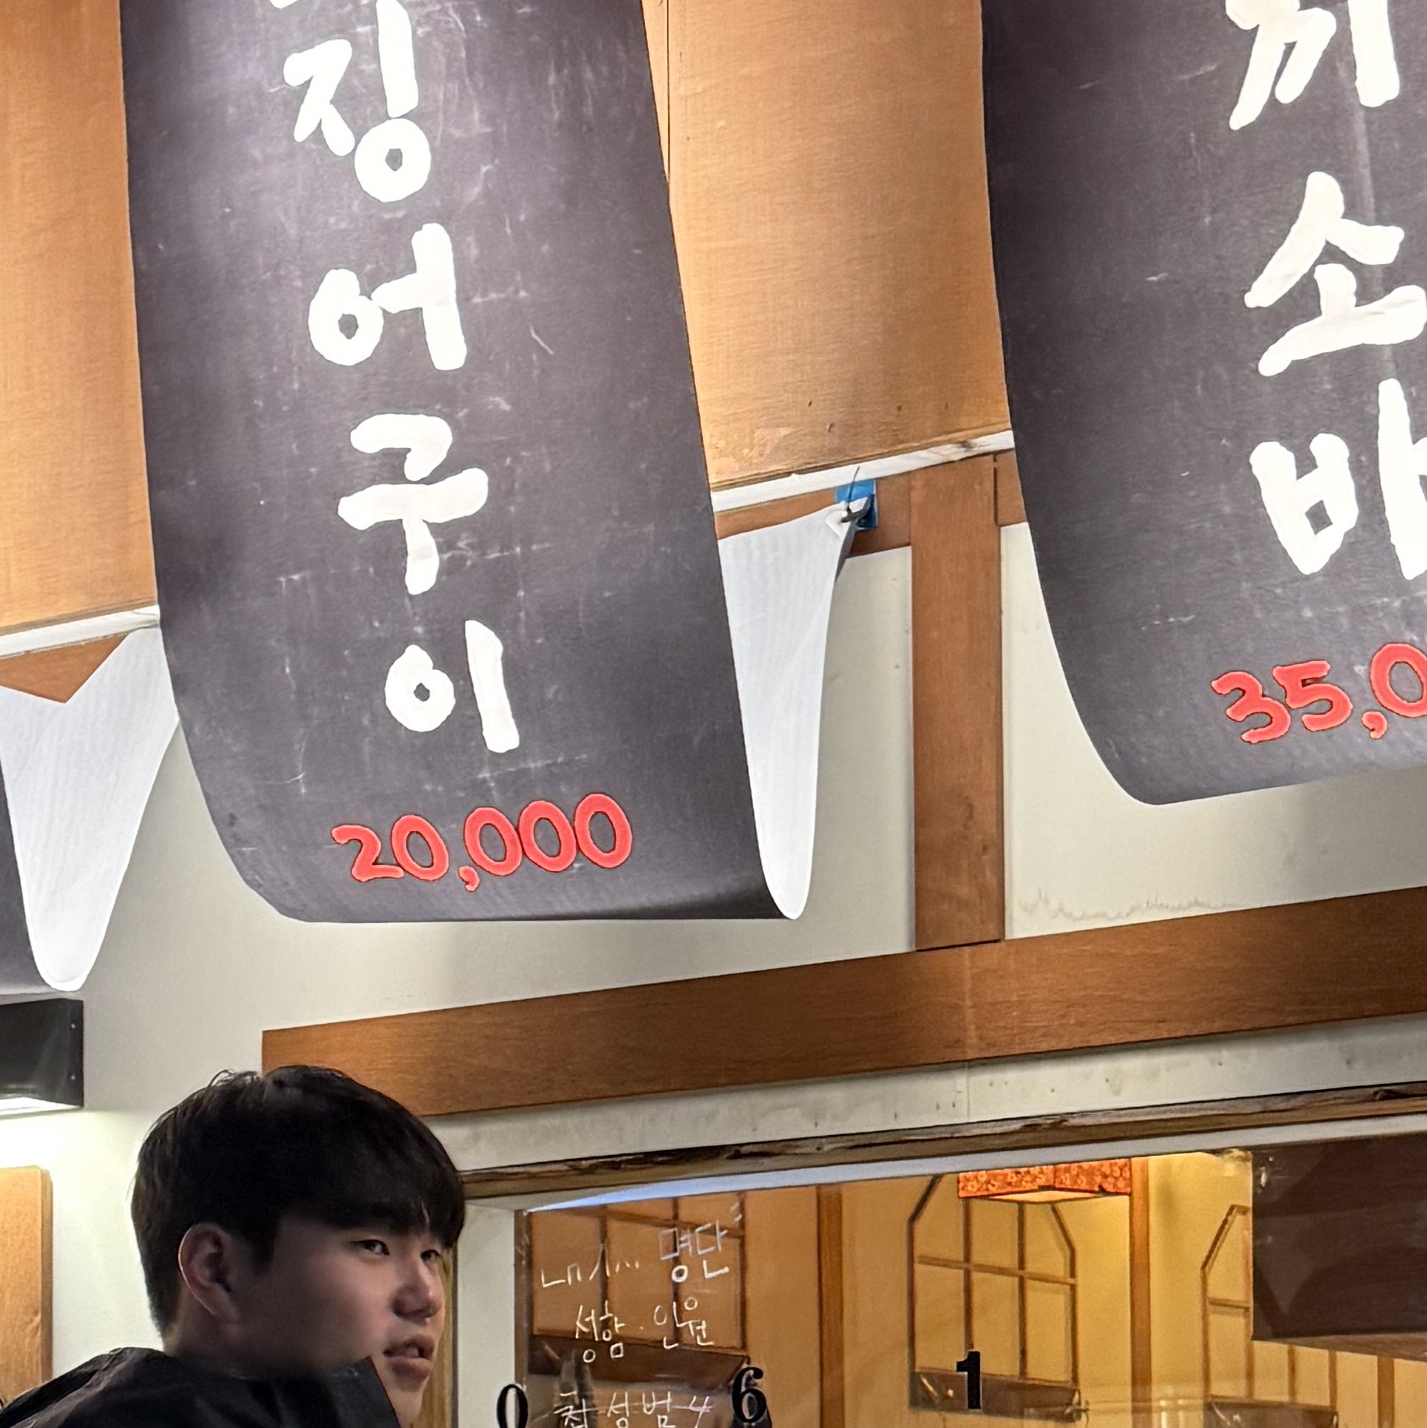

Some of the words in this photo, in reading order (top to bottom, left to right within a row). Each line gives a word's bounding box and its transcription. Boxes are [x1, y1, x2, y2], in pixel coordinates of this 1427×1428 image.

[272, 0, 521, 754] 징어구이
[331, 793, 633, 891] 20,000
[731, 1367, 767, 1423] 6
[956, 1351, 981, 1409] 1
